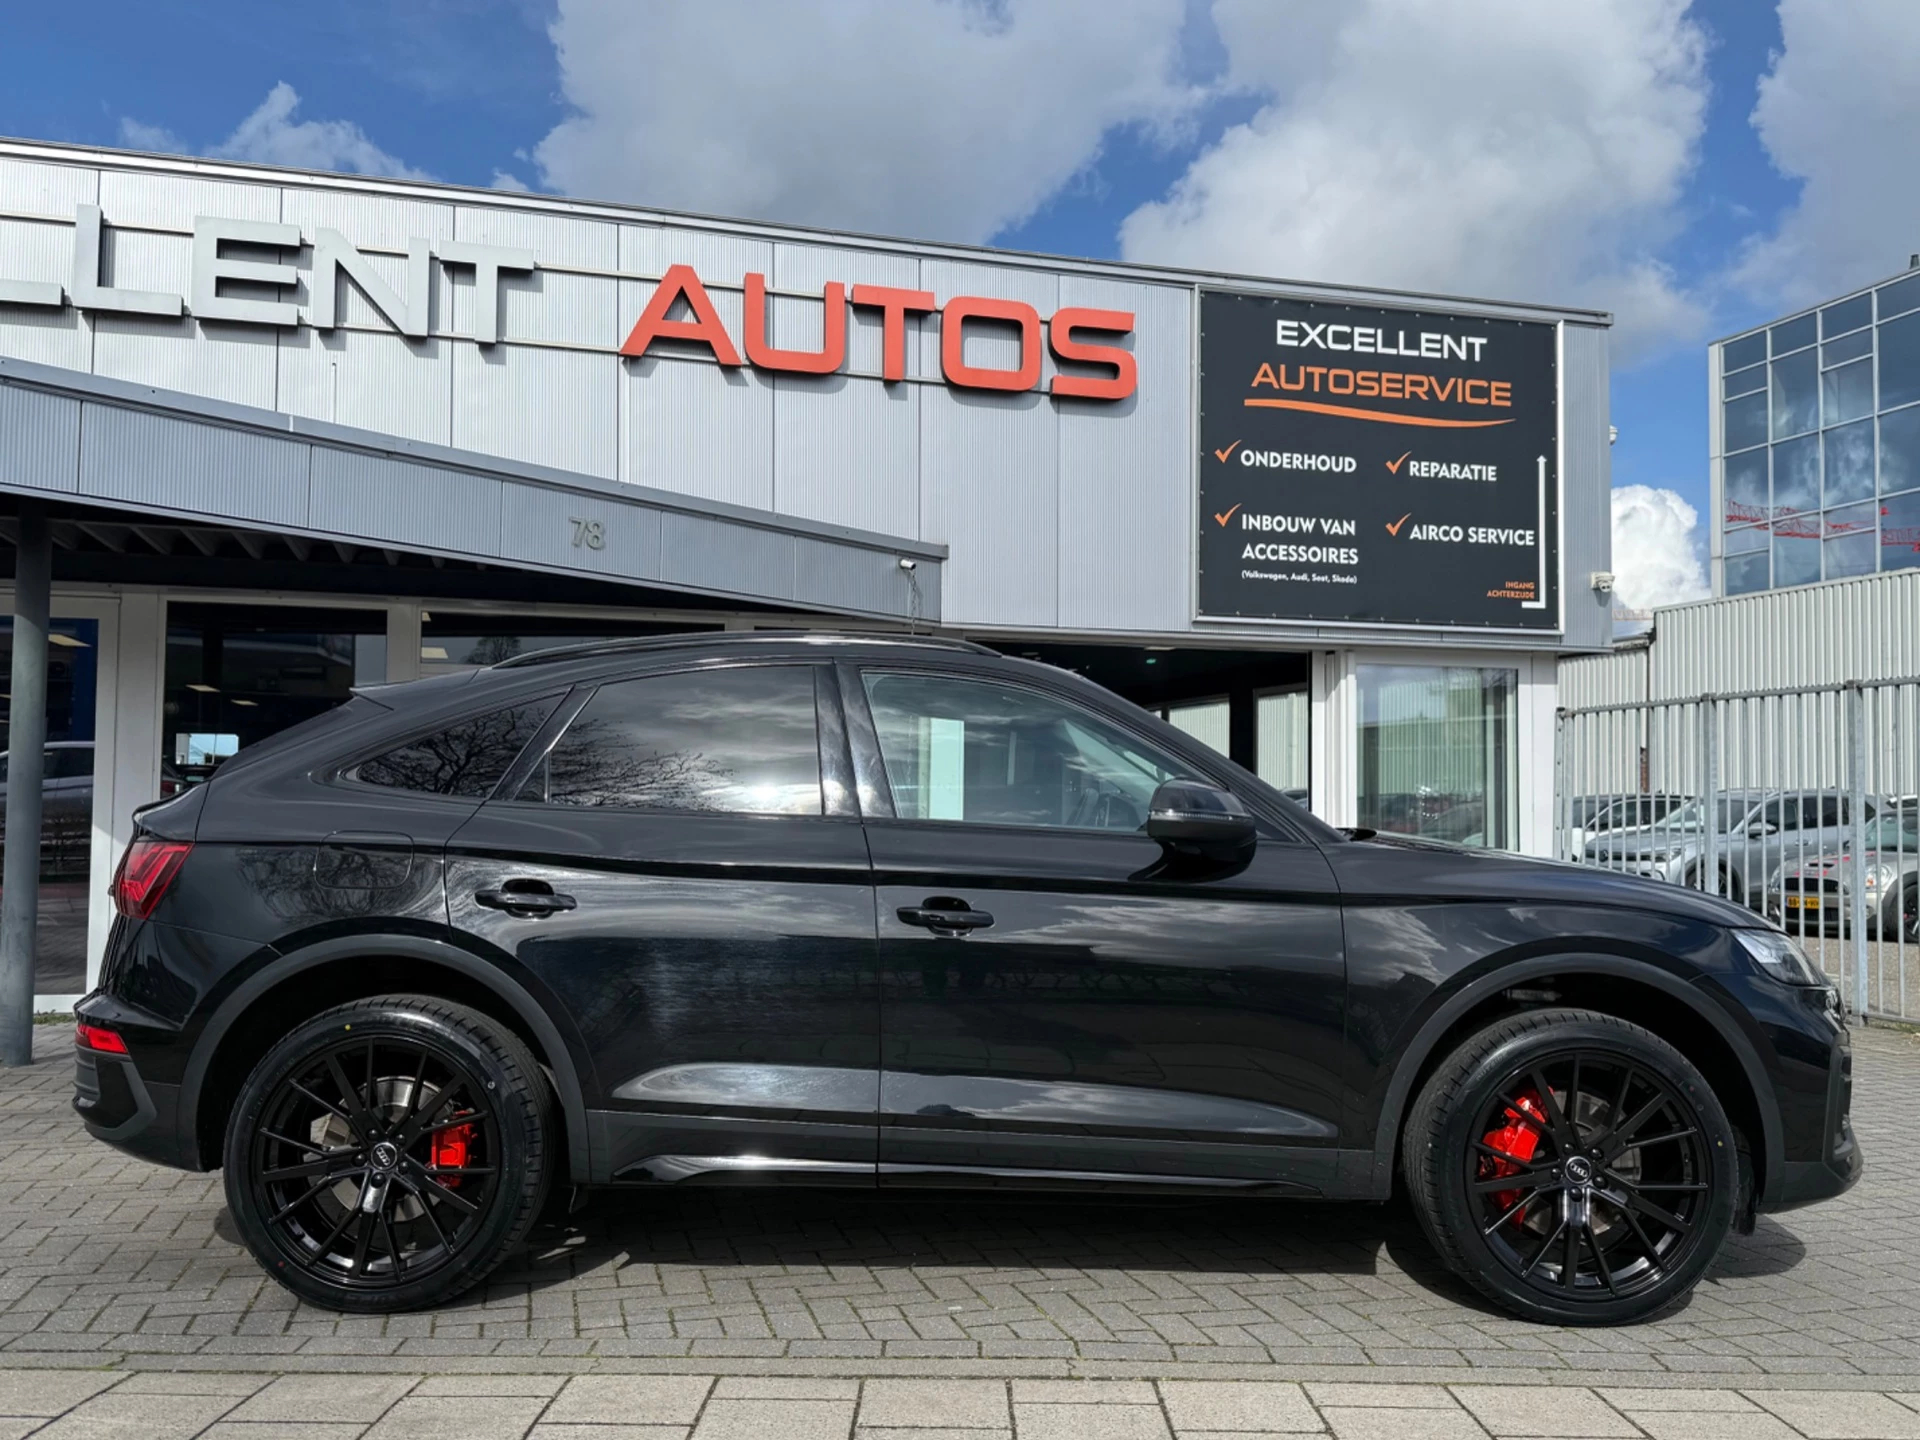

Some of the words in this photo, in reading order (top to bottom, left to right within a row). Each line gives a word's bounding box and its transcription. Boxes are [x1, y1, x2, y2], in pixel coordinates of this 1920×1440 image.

[618, 263, 1138, 400] AUTOS
[1276, 319, 1488, 363] EXCELLENT
[1250, 362, 1512, 407] AUTOSERVICE
[1240, 449, 1357, 473] ONDERHOUD
[1409, 460, 1498, 481] REPARATIE
[568, 516, 605, 551] 78
[1241, 513, 1317, 533] INBOUW
[1319, 518, 1356, 536] VAN
[1409, 523, 1464, 543] AIRCO
[1467, 526, 1535, 546] SERVICE
[1241, 542, 1359, 565] ACCESSOIRES
[1241, 569, 1289, 581] (Volkswagen,
[1290, 572, 1310, 582] Audi,
[1311, 573, 1330, 583] Seat,
[1505, 581, 1535, 590] INGANG
